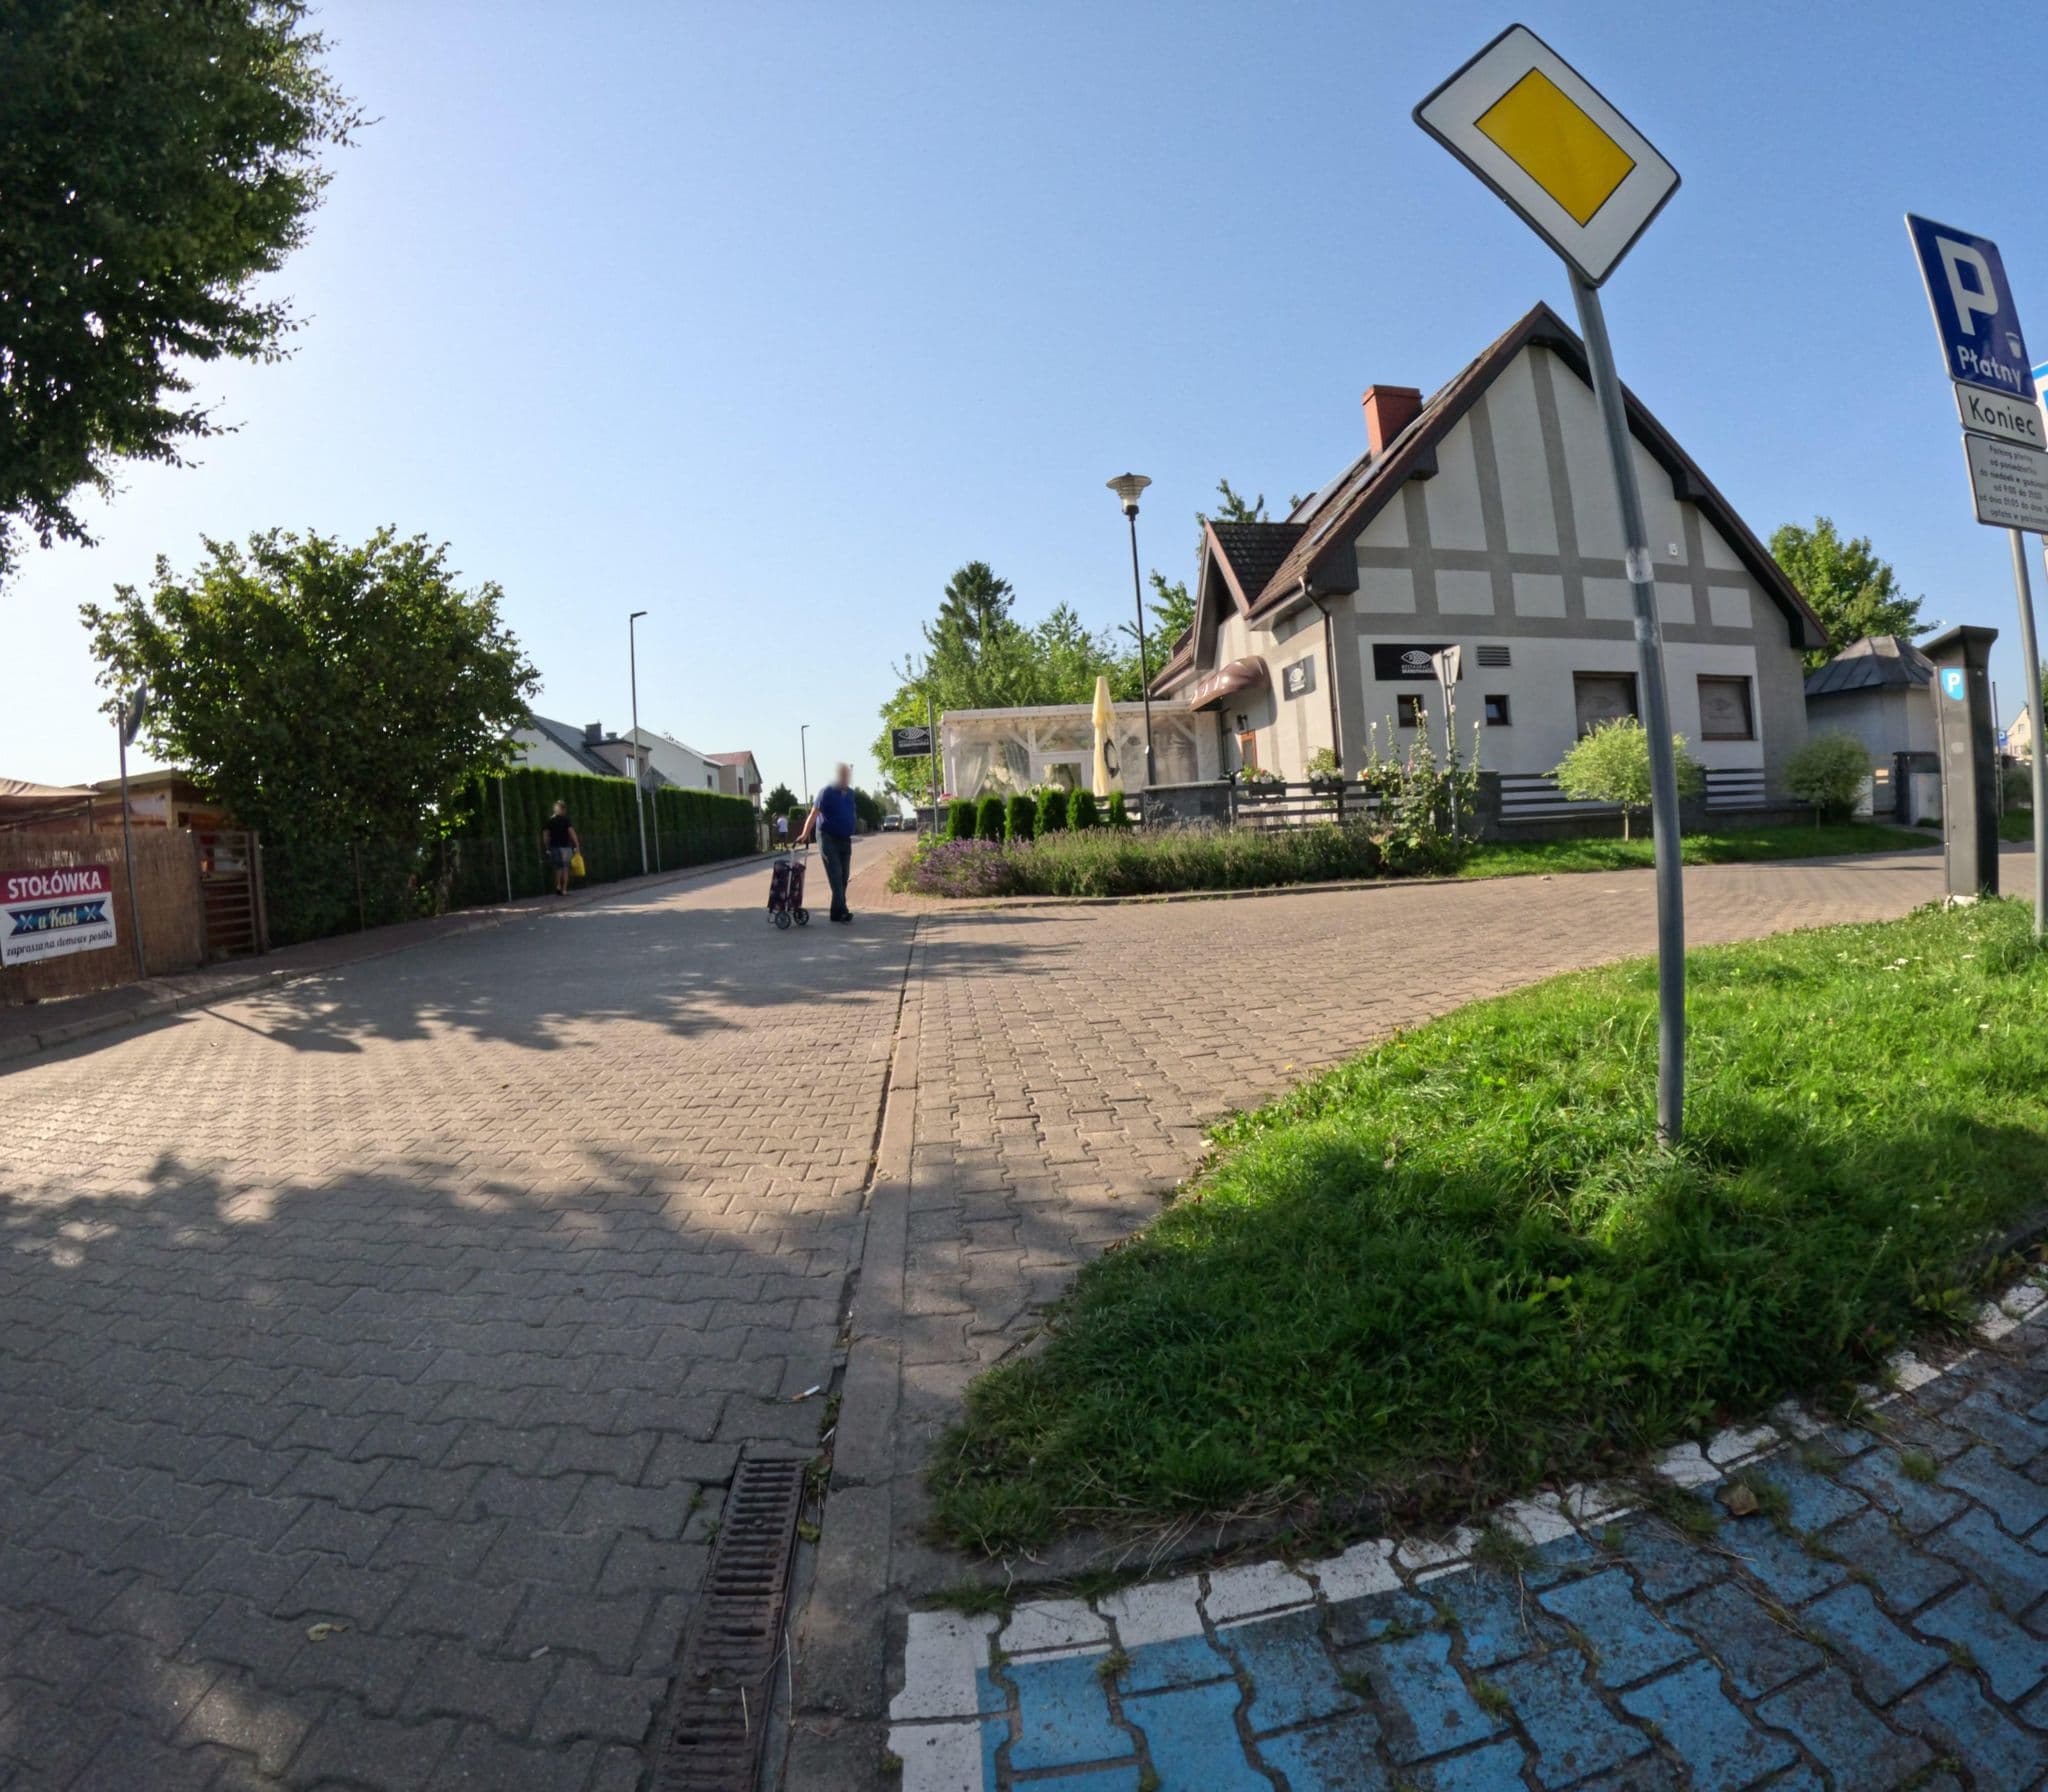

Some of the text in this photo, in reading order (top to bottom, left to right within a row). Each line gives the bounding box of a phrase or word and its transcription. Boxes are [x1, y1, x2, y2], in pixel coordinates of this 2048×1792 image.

[1936, 236, 1999, 336] P
[1957, 345, 2022, 393] Płatny
[1968, 395, 2037, 437] Koniec
[1947, 672, 1961, 693] P
[8, 870, 102, 899] STOŁÓWKA
[38, 907, 78, 929] u Kasi
